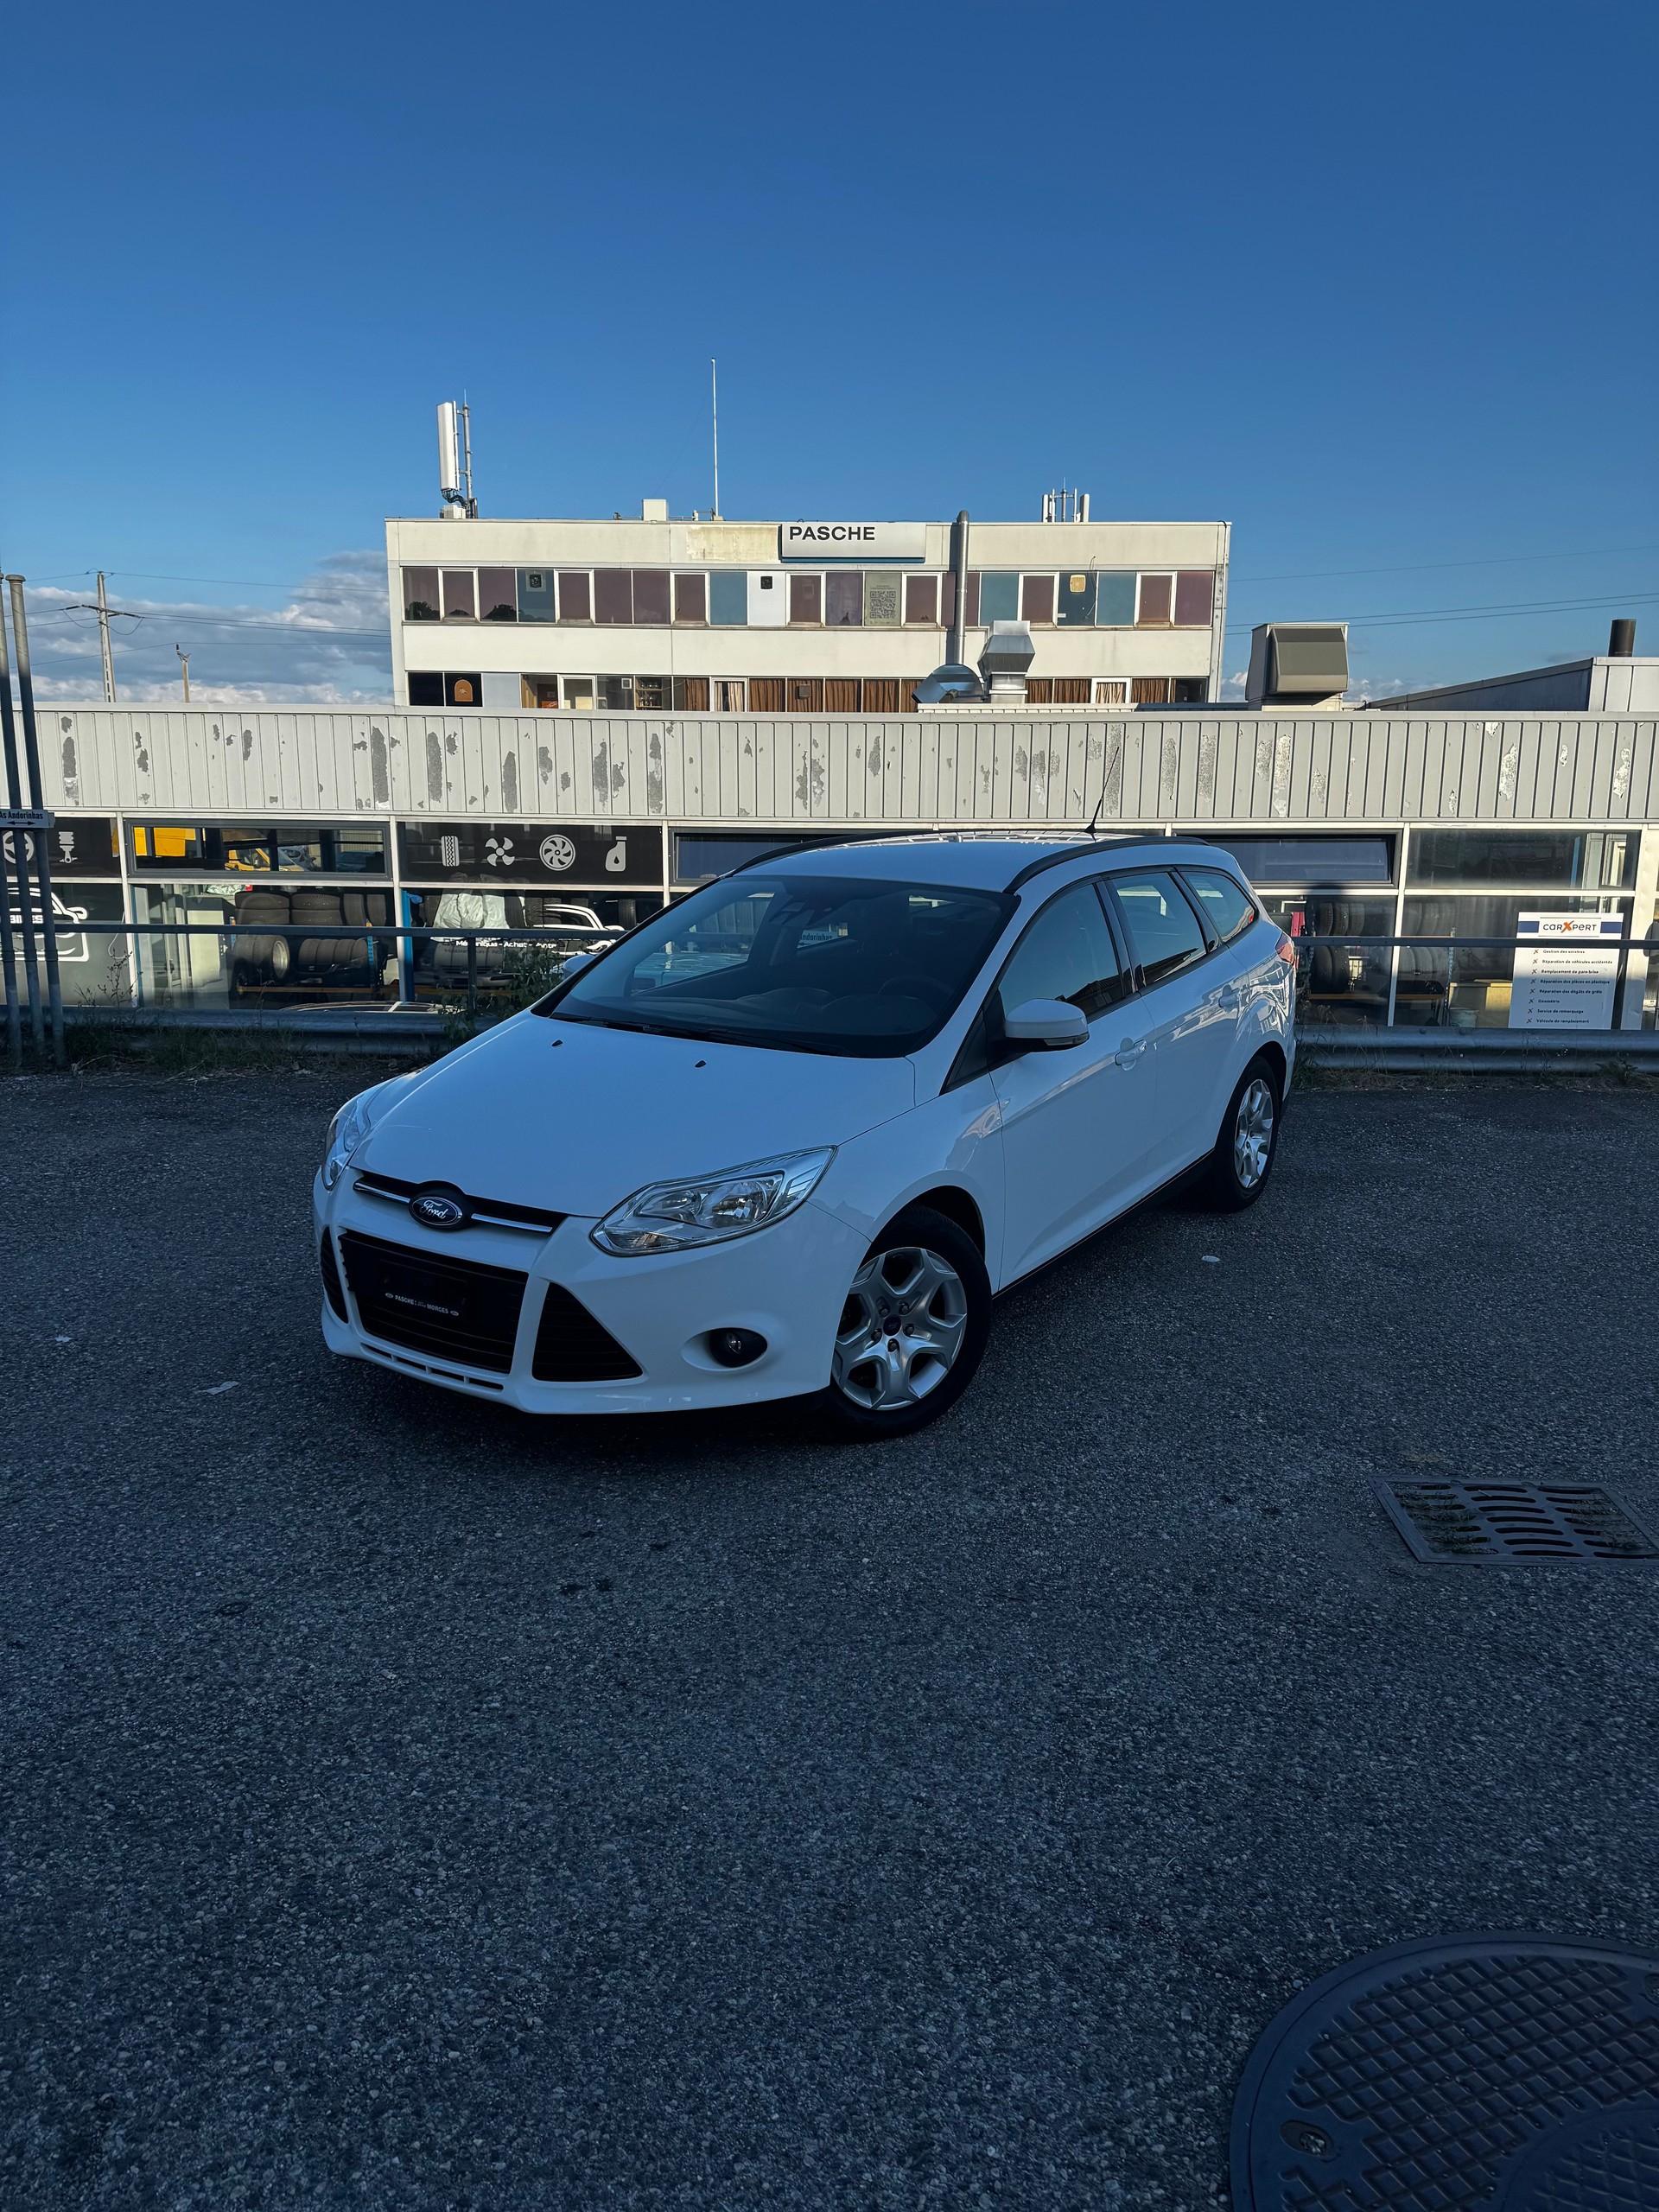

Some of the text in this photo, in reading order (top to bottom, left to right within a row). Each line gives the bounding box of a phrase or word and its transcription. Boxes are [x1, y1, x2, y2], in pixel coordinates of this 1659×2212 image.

[790, 526, 875, 541] PASCHE
[8, 811, 43, 820] Andorinhas
[420, 1199, 448, 1219] Ford
[427, 1303, 448, 1314] MORGES
